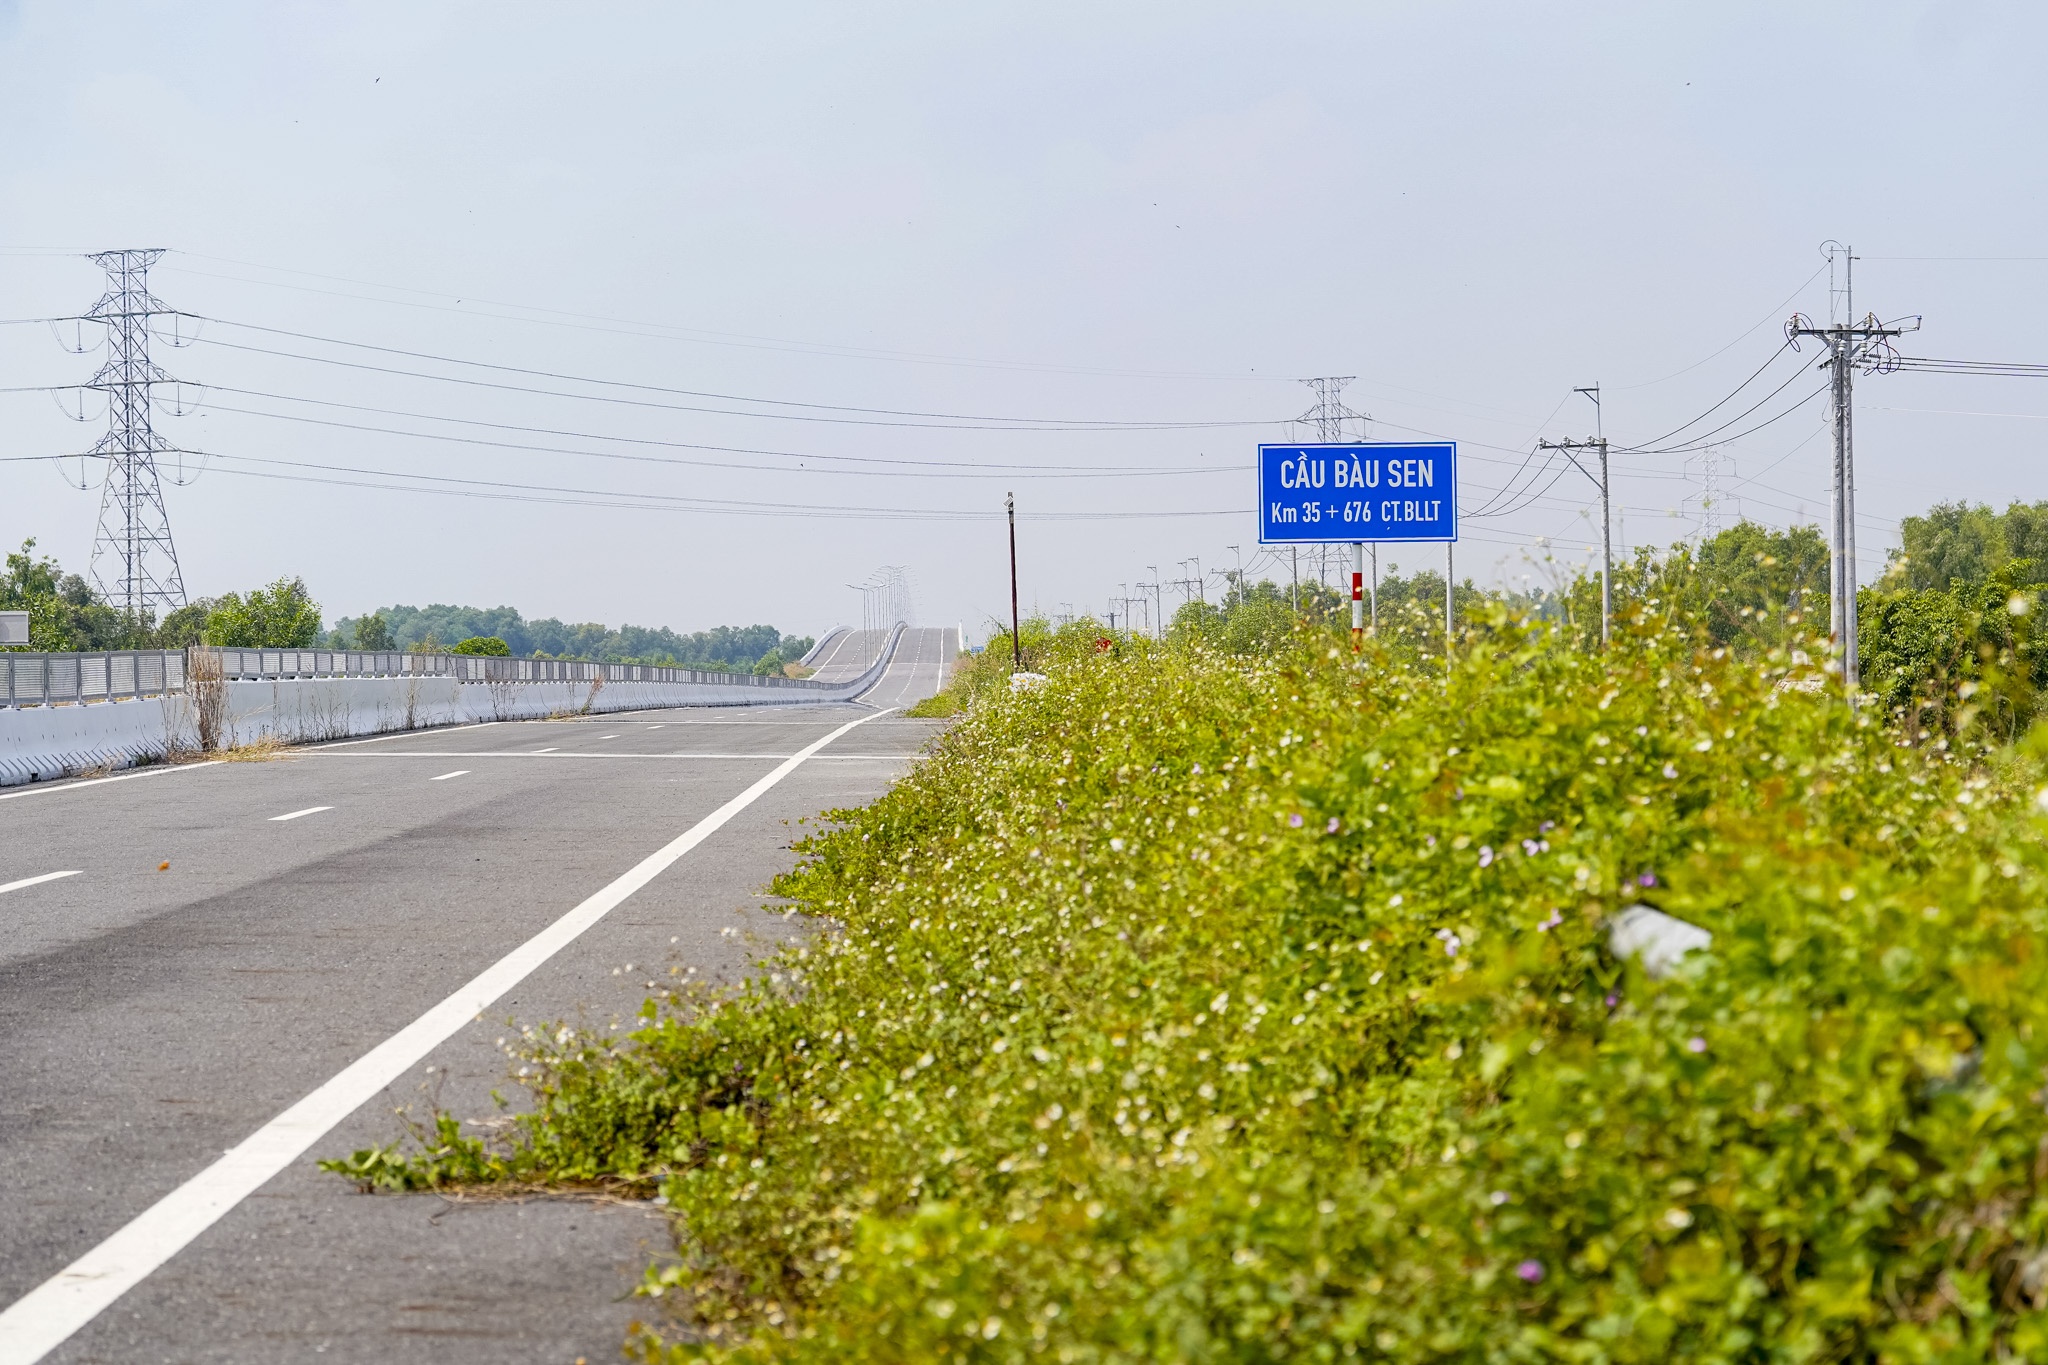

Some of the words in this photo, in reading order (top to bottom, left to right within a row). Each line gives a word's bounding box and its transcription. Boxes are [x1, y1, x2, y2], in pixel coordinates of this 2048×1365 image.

[1280, 451, 1326, 489] CẦU
[1334, 453, 1380, 488] BÀU
[1387, 459, 1433, 488] SEN
[1271, 502, 1297, 523] Km
[1302, 501, 1321, 523] 35
[1325, 504, 1339, 519] +
[1343, 501, 1372, 523] 676
[1381, 500, 1441, 522] CT.BLLT
